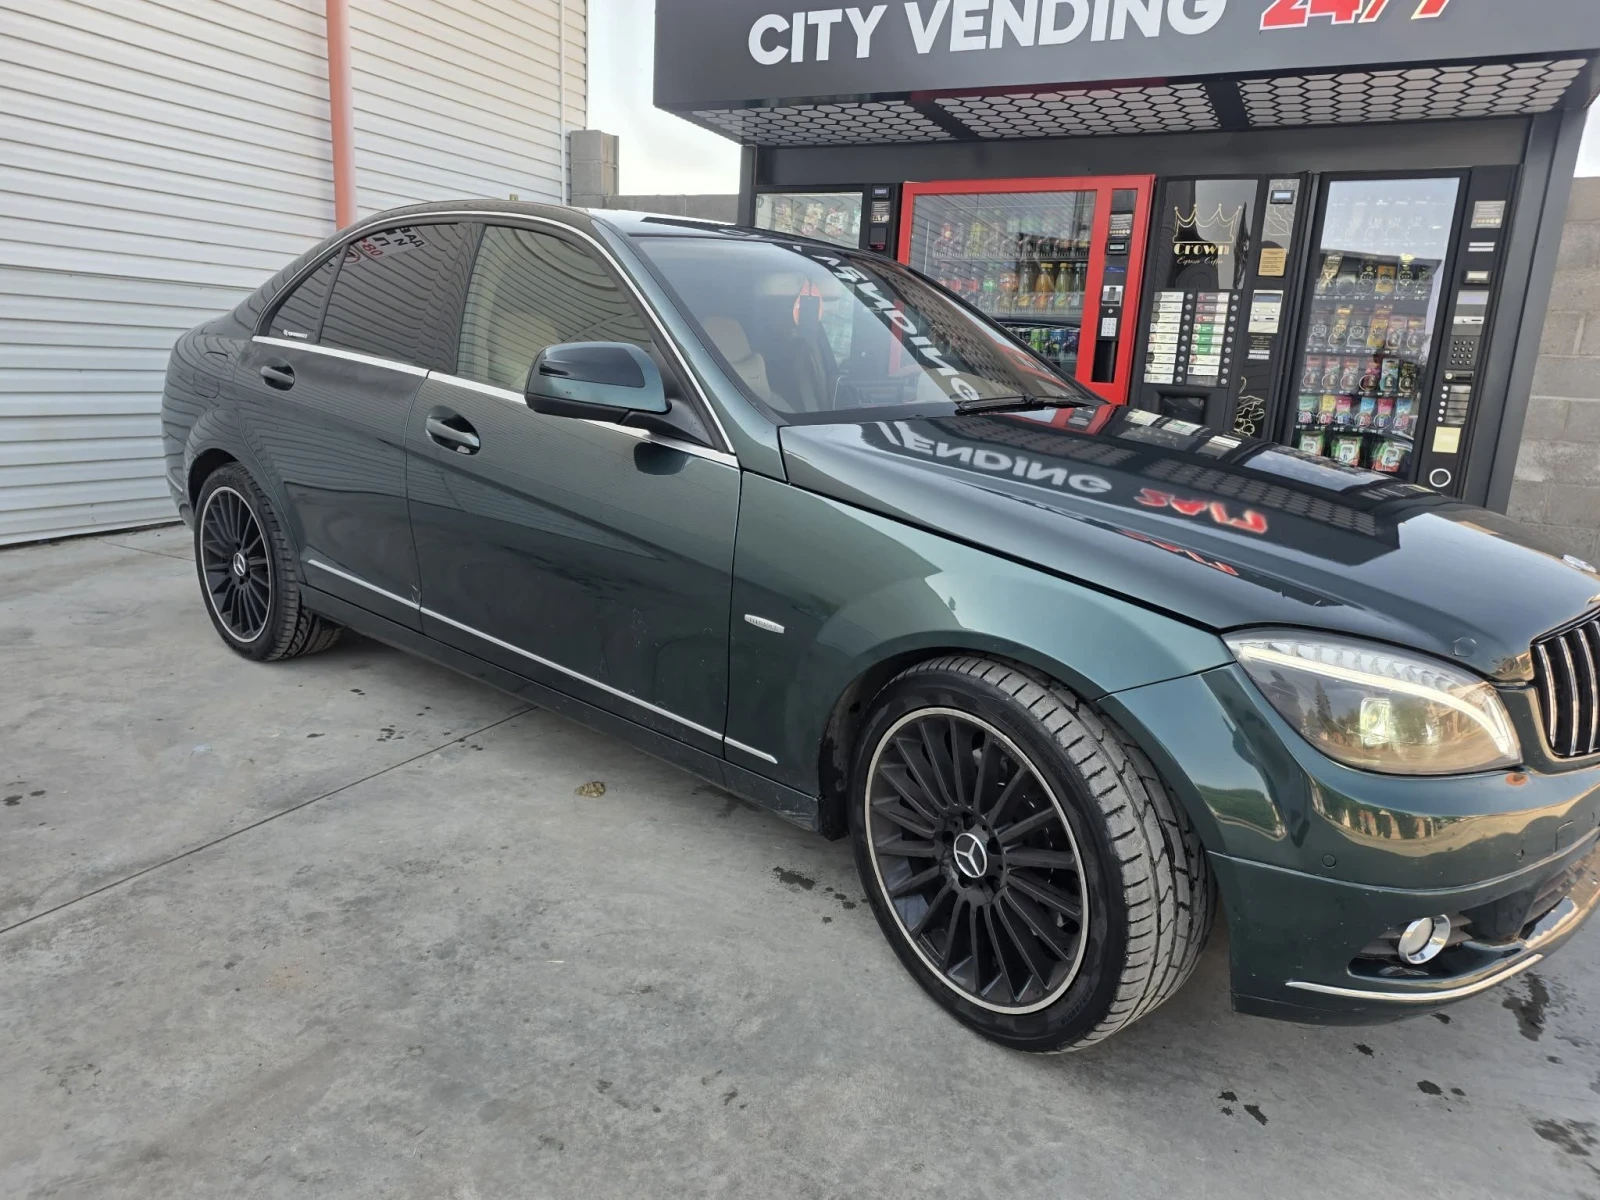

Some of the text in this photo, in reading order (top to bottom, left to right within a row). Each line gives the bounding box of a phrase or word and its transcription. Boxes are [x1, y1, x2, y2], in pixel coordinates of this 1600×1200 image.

[748, 5, 888, 65] CITY
[904, 0, 1227, 54] VENDING
[1173, 243, 1230, 255] Crown
